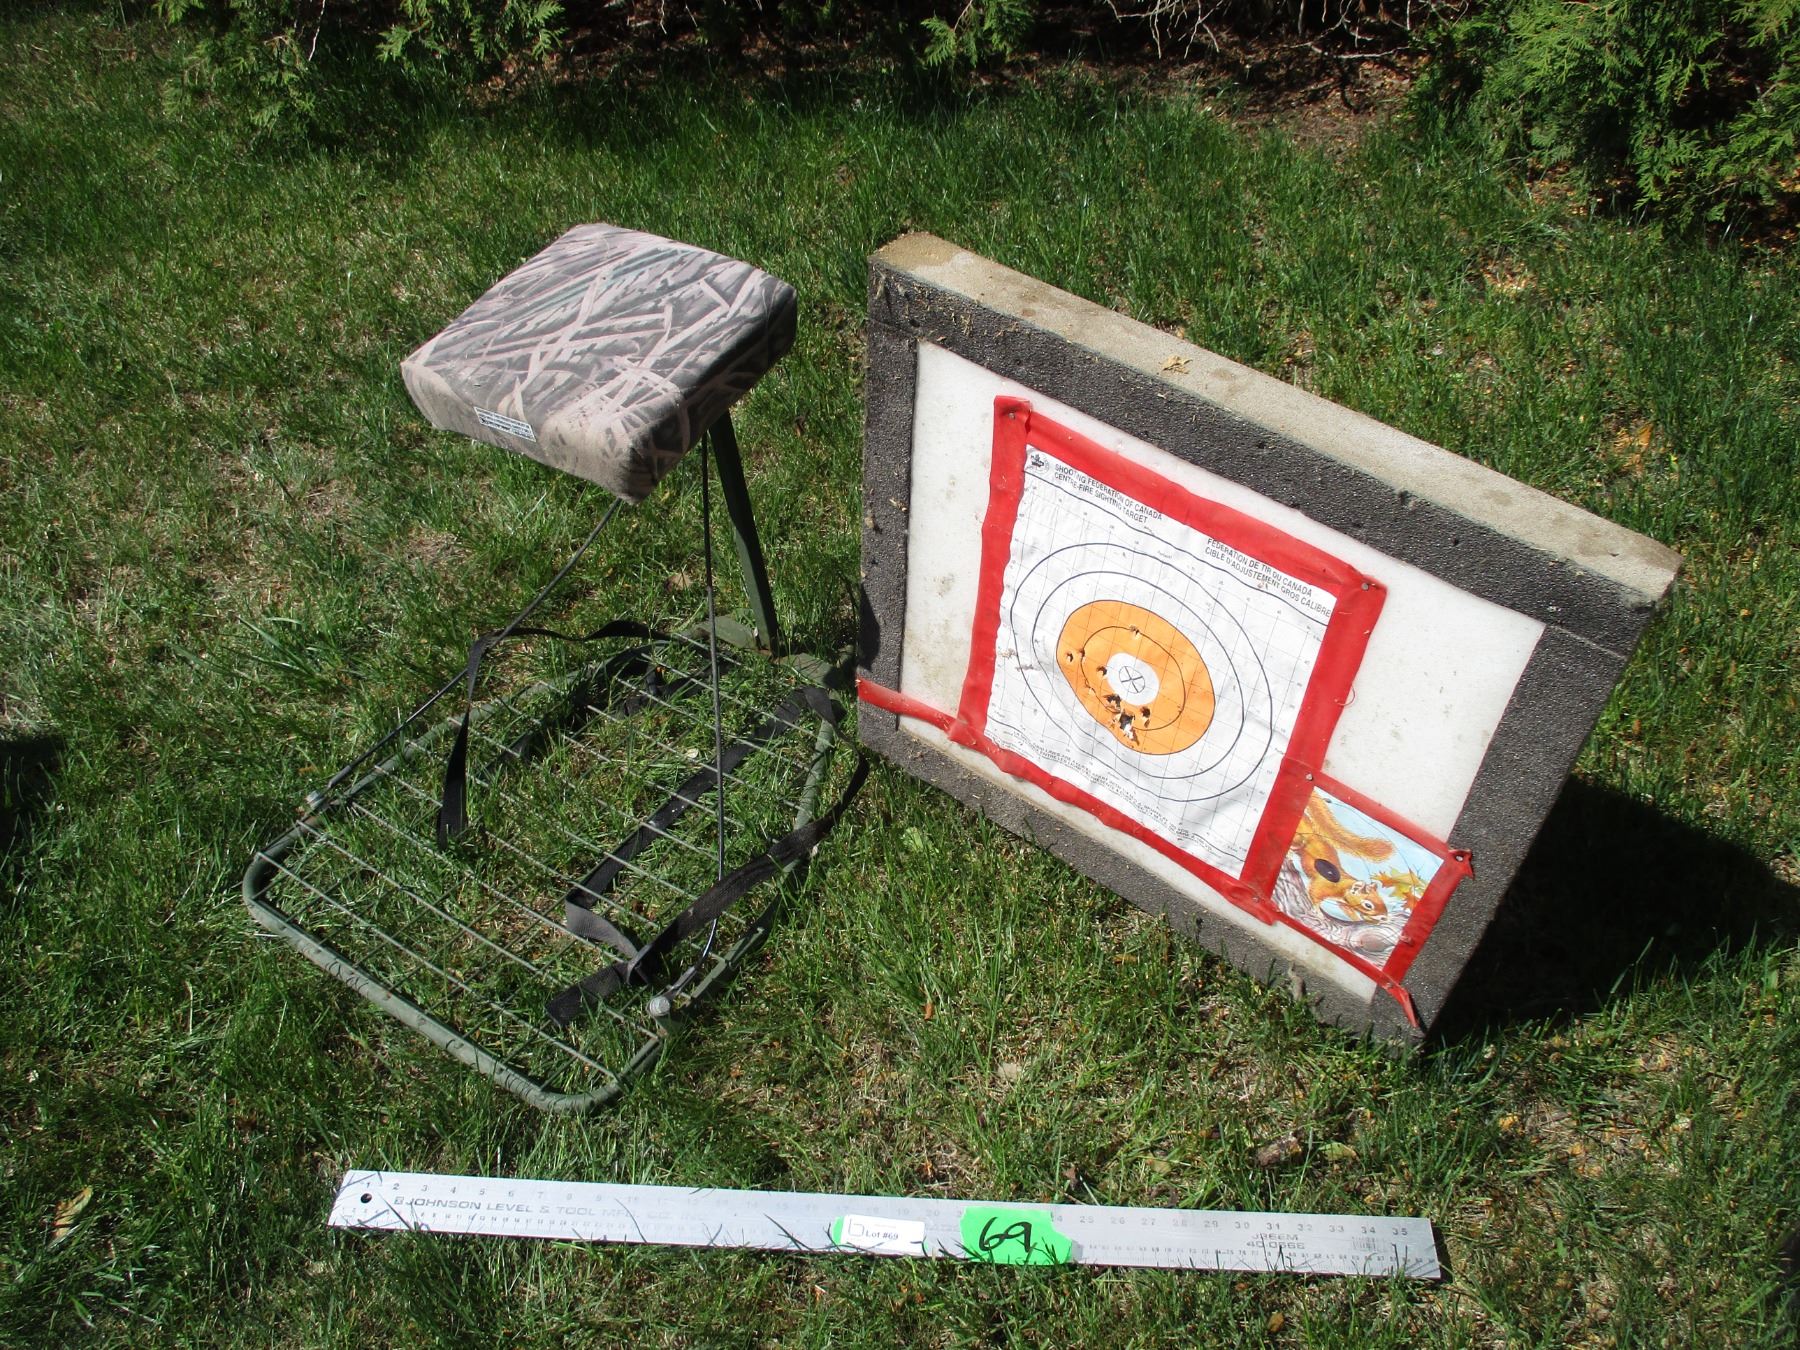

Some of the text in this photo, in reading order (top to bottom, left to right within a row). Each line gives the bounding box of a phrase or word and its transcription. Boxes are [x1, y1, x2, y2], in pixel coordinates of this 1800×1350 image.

[1055, 464, 1163, 520] SHOOTING FEDERATION OF CANADA
[1094, 491, 1122, 510] SIGHTING
[1122, 507, 1148, 524] TARGET
[1204, 546, 1332, 618] CIBLE D'ADJUSTEMENT GROS CALIBRE
[1249, 559, 1259, 570] DE
[1261, 564, 1272, 575] TIR
[1272, 570, 1283, 581] DU
[1282, 577, 1312, 597] CANADA
[392, 1182, 400, 1191] 2
[421, 1184, 428, 1192] 3
[450, 1186, 456, 1194] 4
[479, 1188, 486, 1196] 5
[508, 1190, 515, 1198] 6
[537, 1191, 544, 1199] 7
[1111, 1217, 1126, 1225] 26
[1141, 1218, 1156, 1226] 27
[1204, 1220, 1219, 1228] 29
[1234, 1221, 1250, 1230] 30
[1266, 1222, 1280, 1230] 31
[1297, 1224, 1312, 1232] 32
[1329, 1225, 1344, 1233] 33
[1361, 1226, 1376, 1234] 34
[1392, 1227, 1408, 1236] 35
[406, 1197, 482, 1210] JOHNSON
[486, 1203, 534, 1213] LEVEL
[539, 1205, 550, 1214] &
[556, 1206, 596, 1217] TOOL
[865, 1229, 899, 1241] Lot #69
[978, 1216, 1033, 1253] 69
